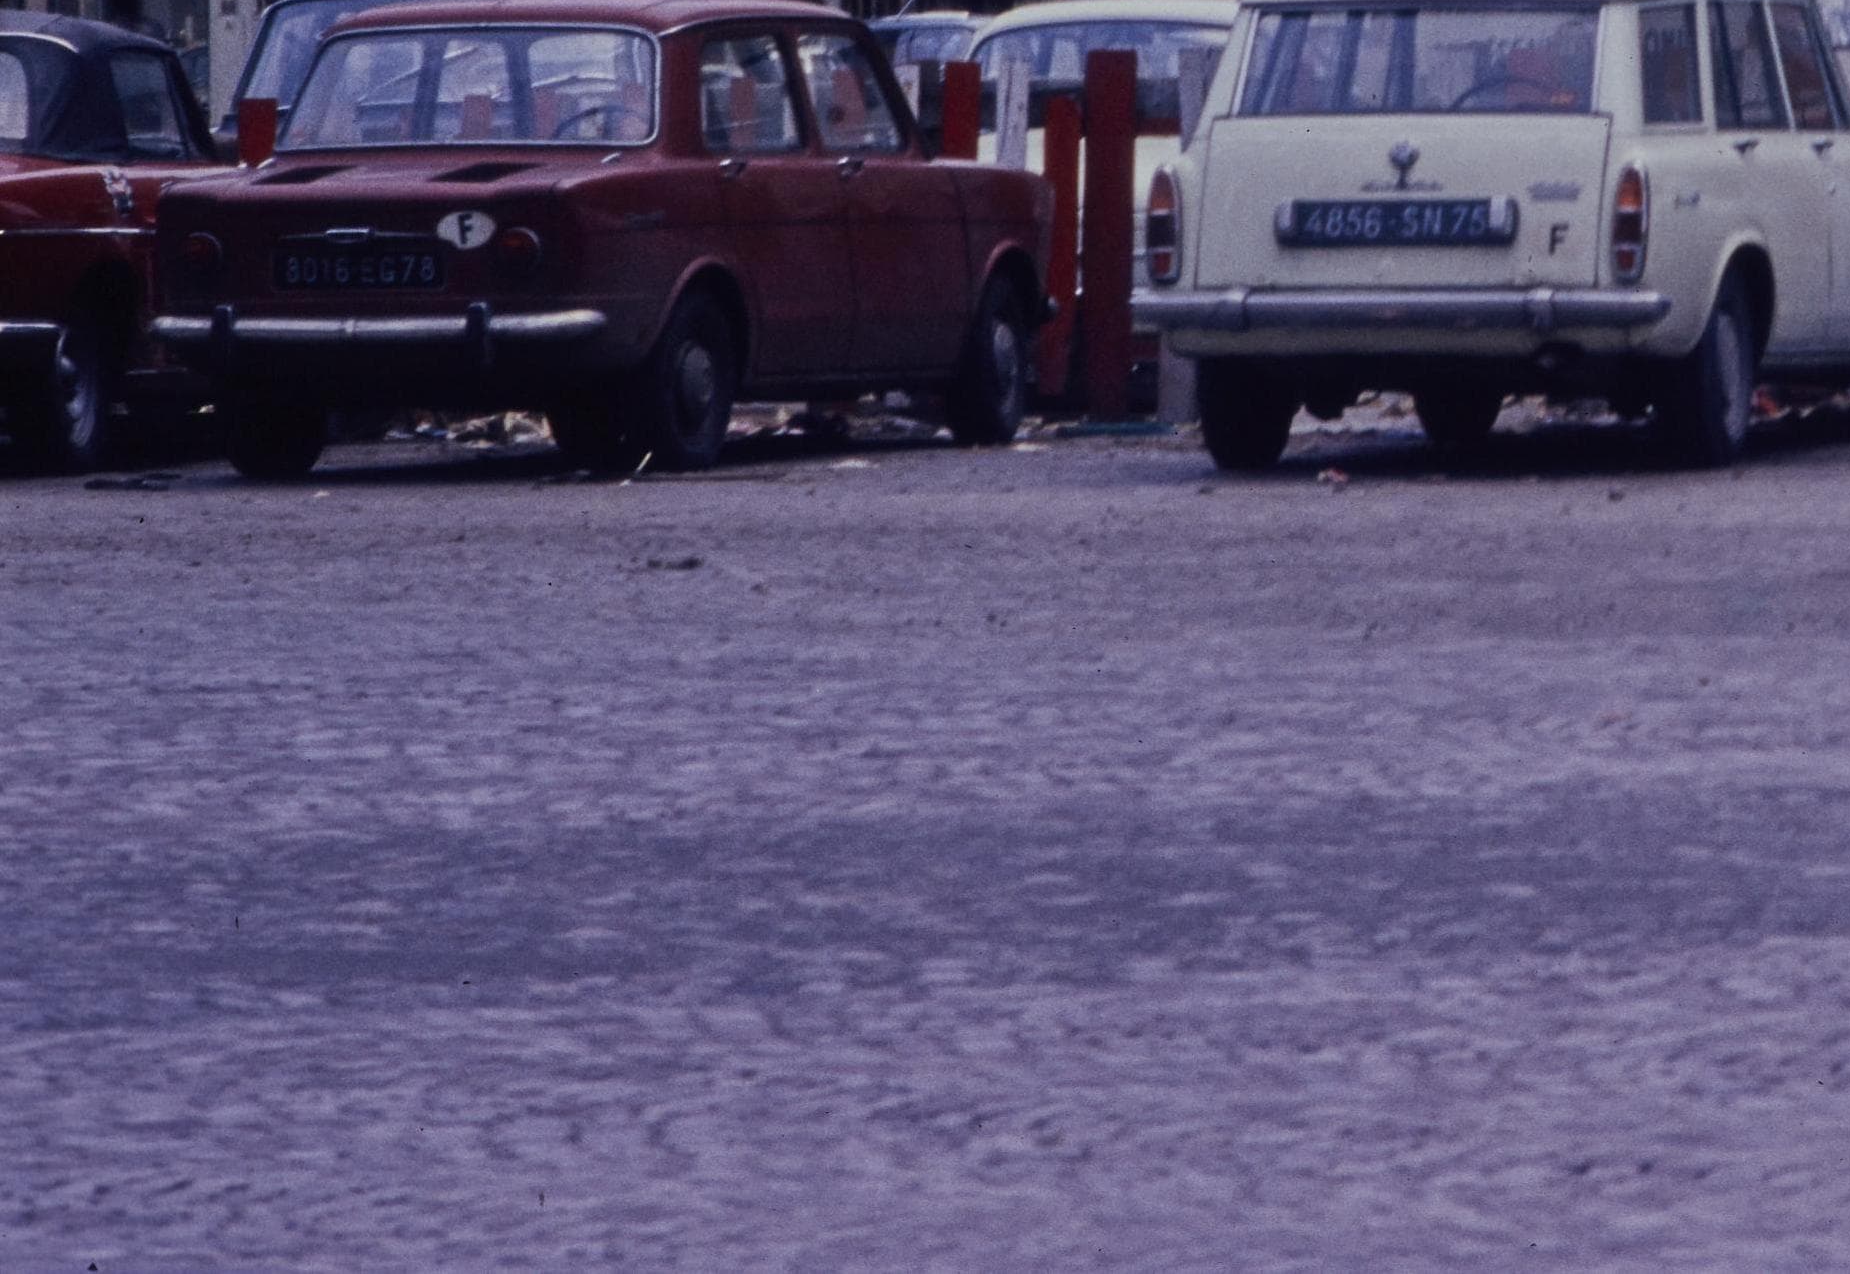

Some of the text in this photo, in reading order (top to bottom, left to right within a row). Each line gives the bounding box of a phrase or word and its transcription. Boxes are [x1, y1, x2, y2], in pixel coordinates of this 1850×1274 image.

[458, 212, 474, 245] F
[1304, 206, 1383, 238] 4856
[1549, 222, 1570, 257] F
